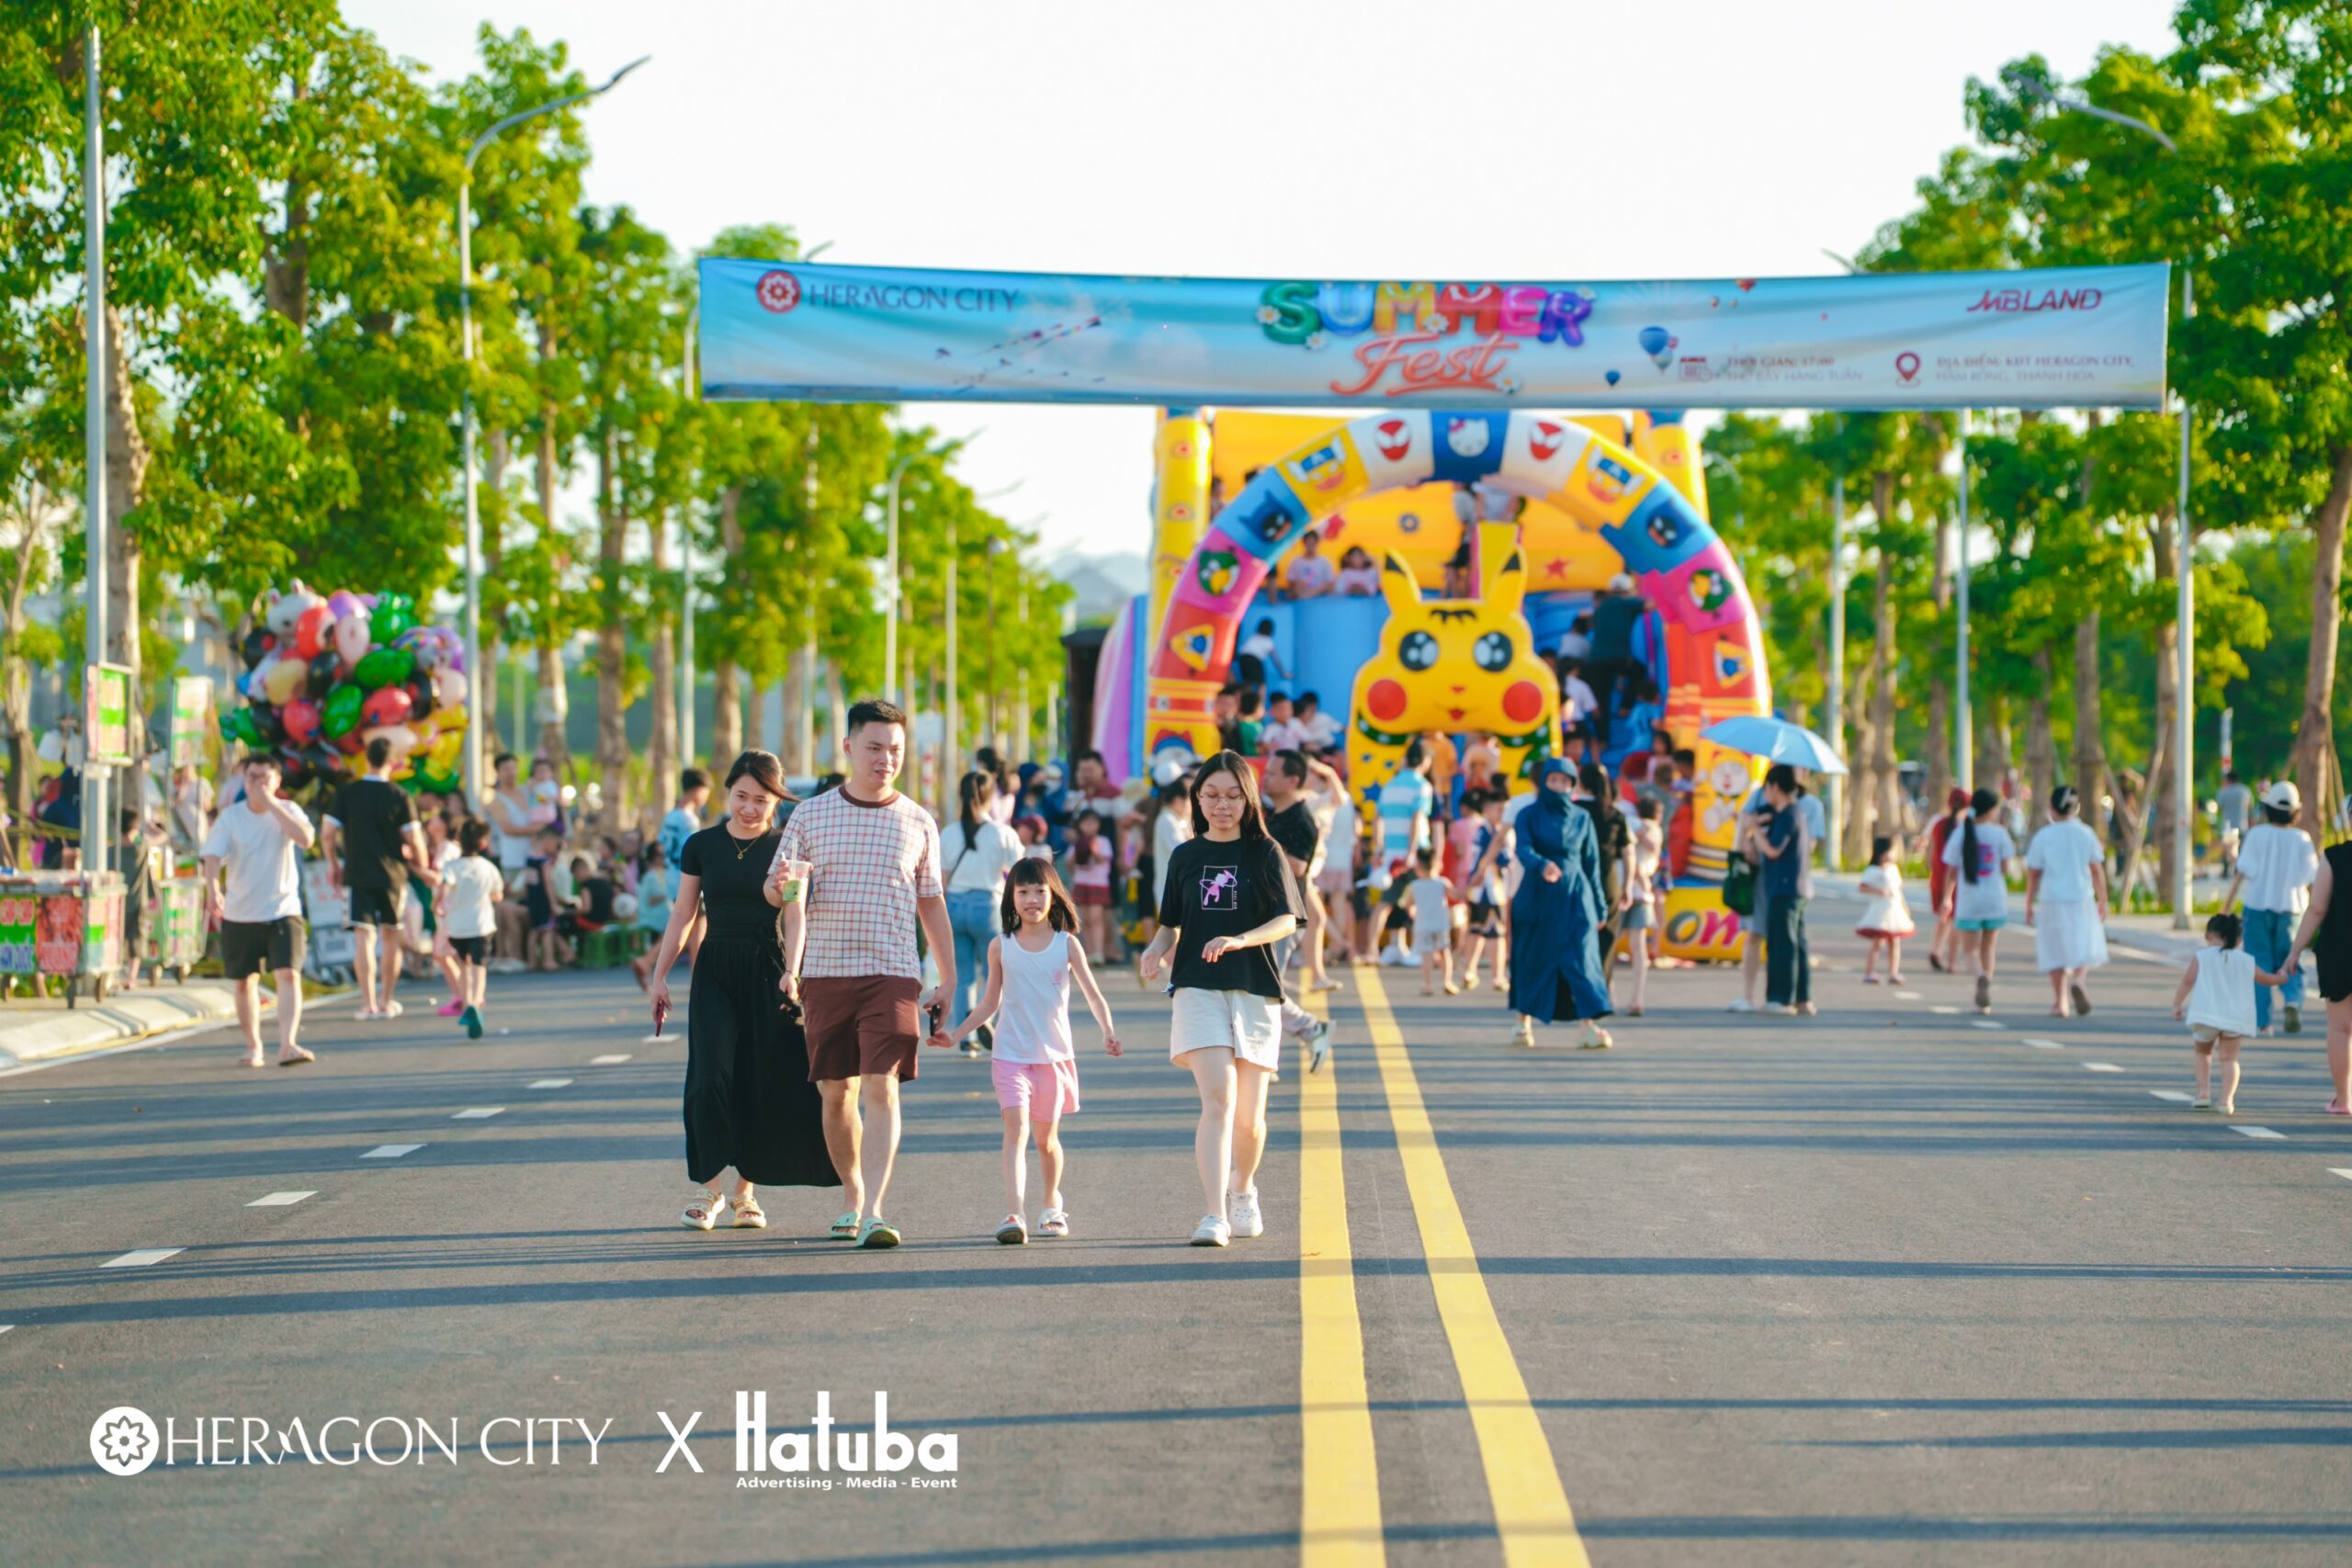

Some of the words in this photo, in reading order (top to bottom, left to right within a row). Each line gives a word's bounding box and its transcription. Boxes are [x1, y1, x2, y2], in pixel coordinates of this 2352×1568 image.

[809, 283, 948, 310] HERAGON
[955, 287, 1020, 312] CITY
[1260, 281, 1594, 347] SUMMER
[1965, 288, 2103, 312] MBLAND
[1329, 333, 1520, 397] Fest
